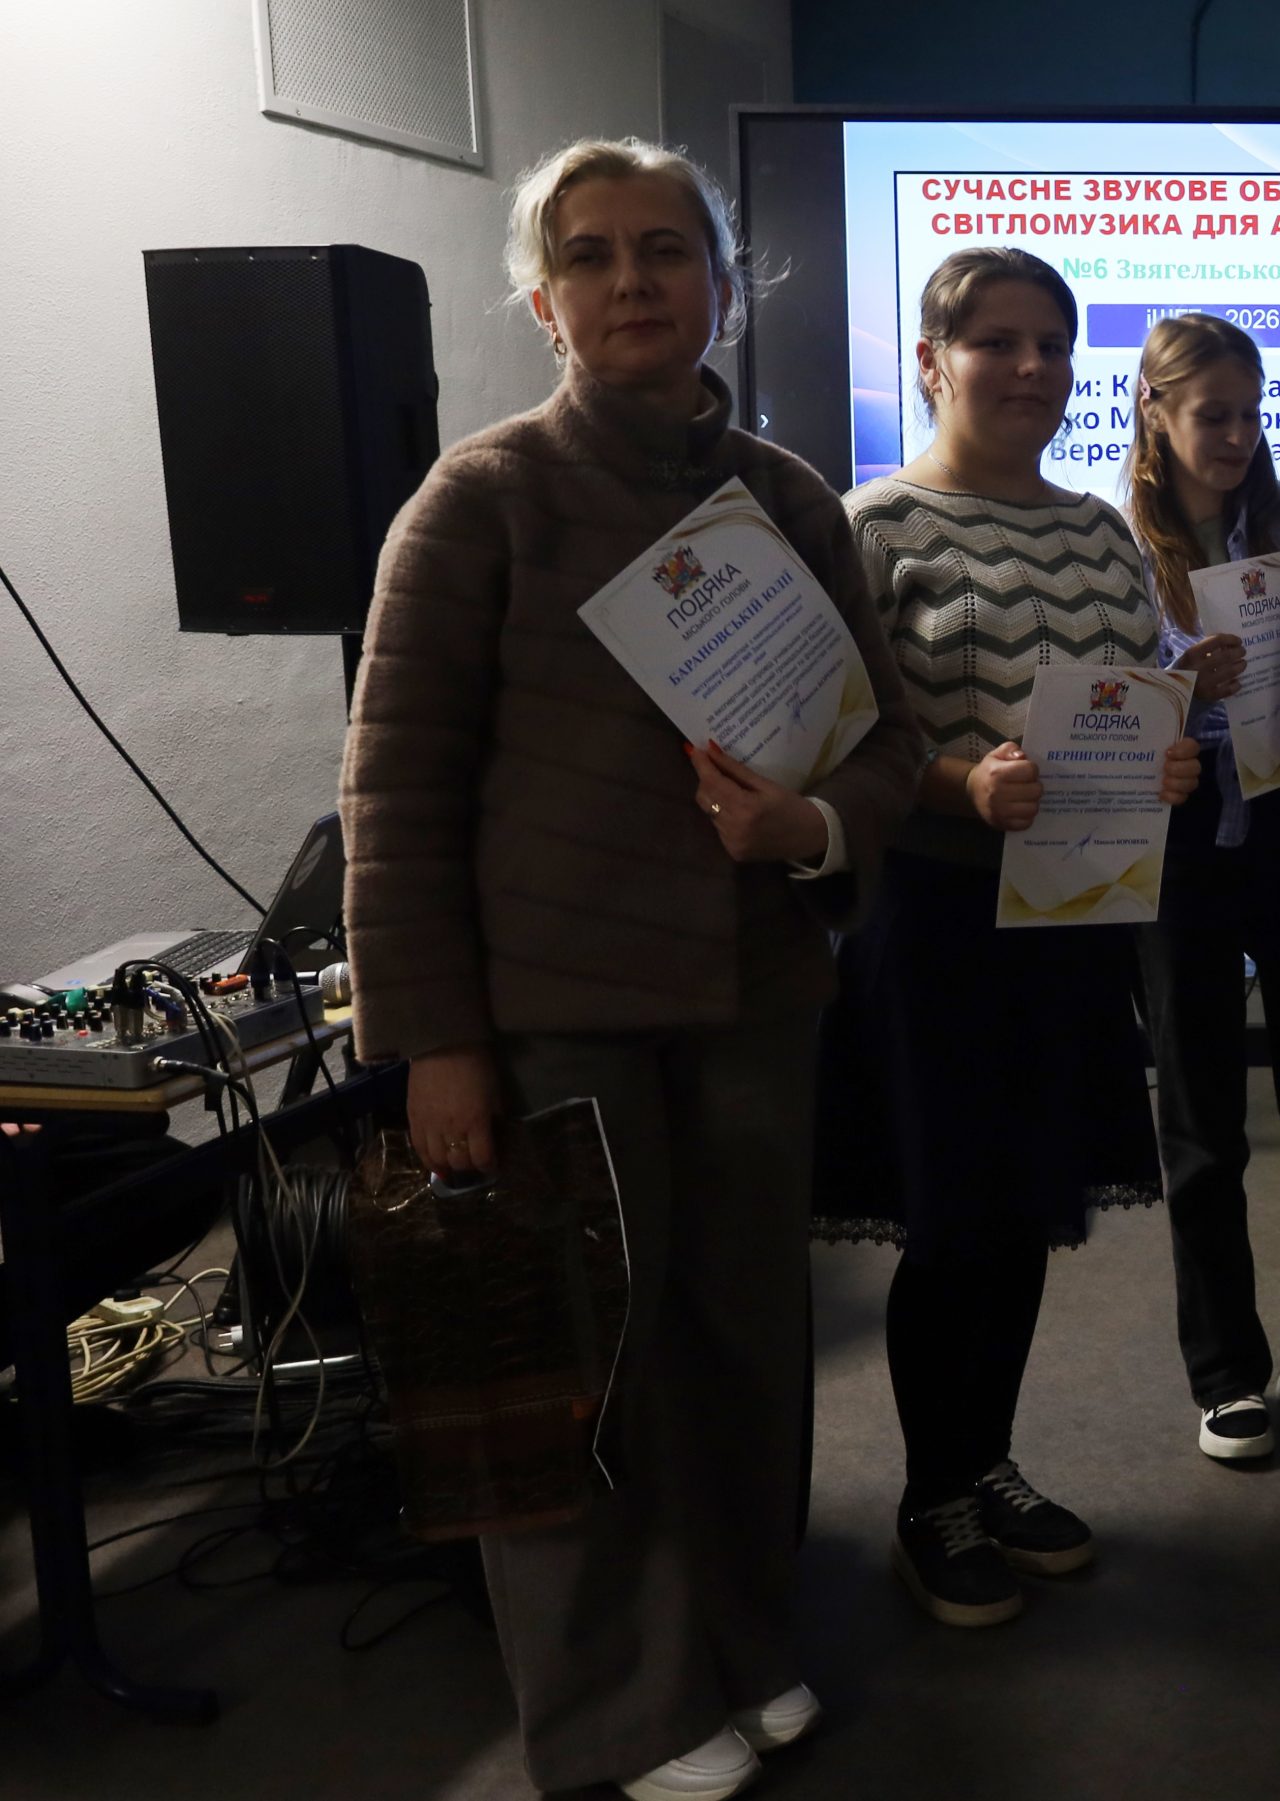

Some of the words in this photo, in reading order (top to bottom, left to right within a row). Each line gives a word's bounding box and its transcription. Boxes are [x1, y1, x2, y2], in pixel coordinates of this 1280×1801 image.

[922, 179, 1072, 201] СУЧАСНЕ
[1083, 179, 1228, 201] ЗВУКОВЕ
[931, 213, 1182, 235] СВІТЛОМУЗИКА
[1193, 214, 1259, 239] ДЛЯ
[1063, 258, 1108, 280] №6
[1225, 309, 1280, 329] 2026
[666, 563, 742, 629] ПОДЯКА
[669, 596, 763, 686] БАРАНОВСЬКІЙ
[1073, 714, 1140, 731] ПОДЯКА
[1047, 750, 1116, 762] ВЕРНИГОРІ
[1119, 750, 1156, 762] СОФІЇ
